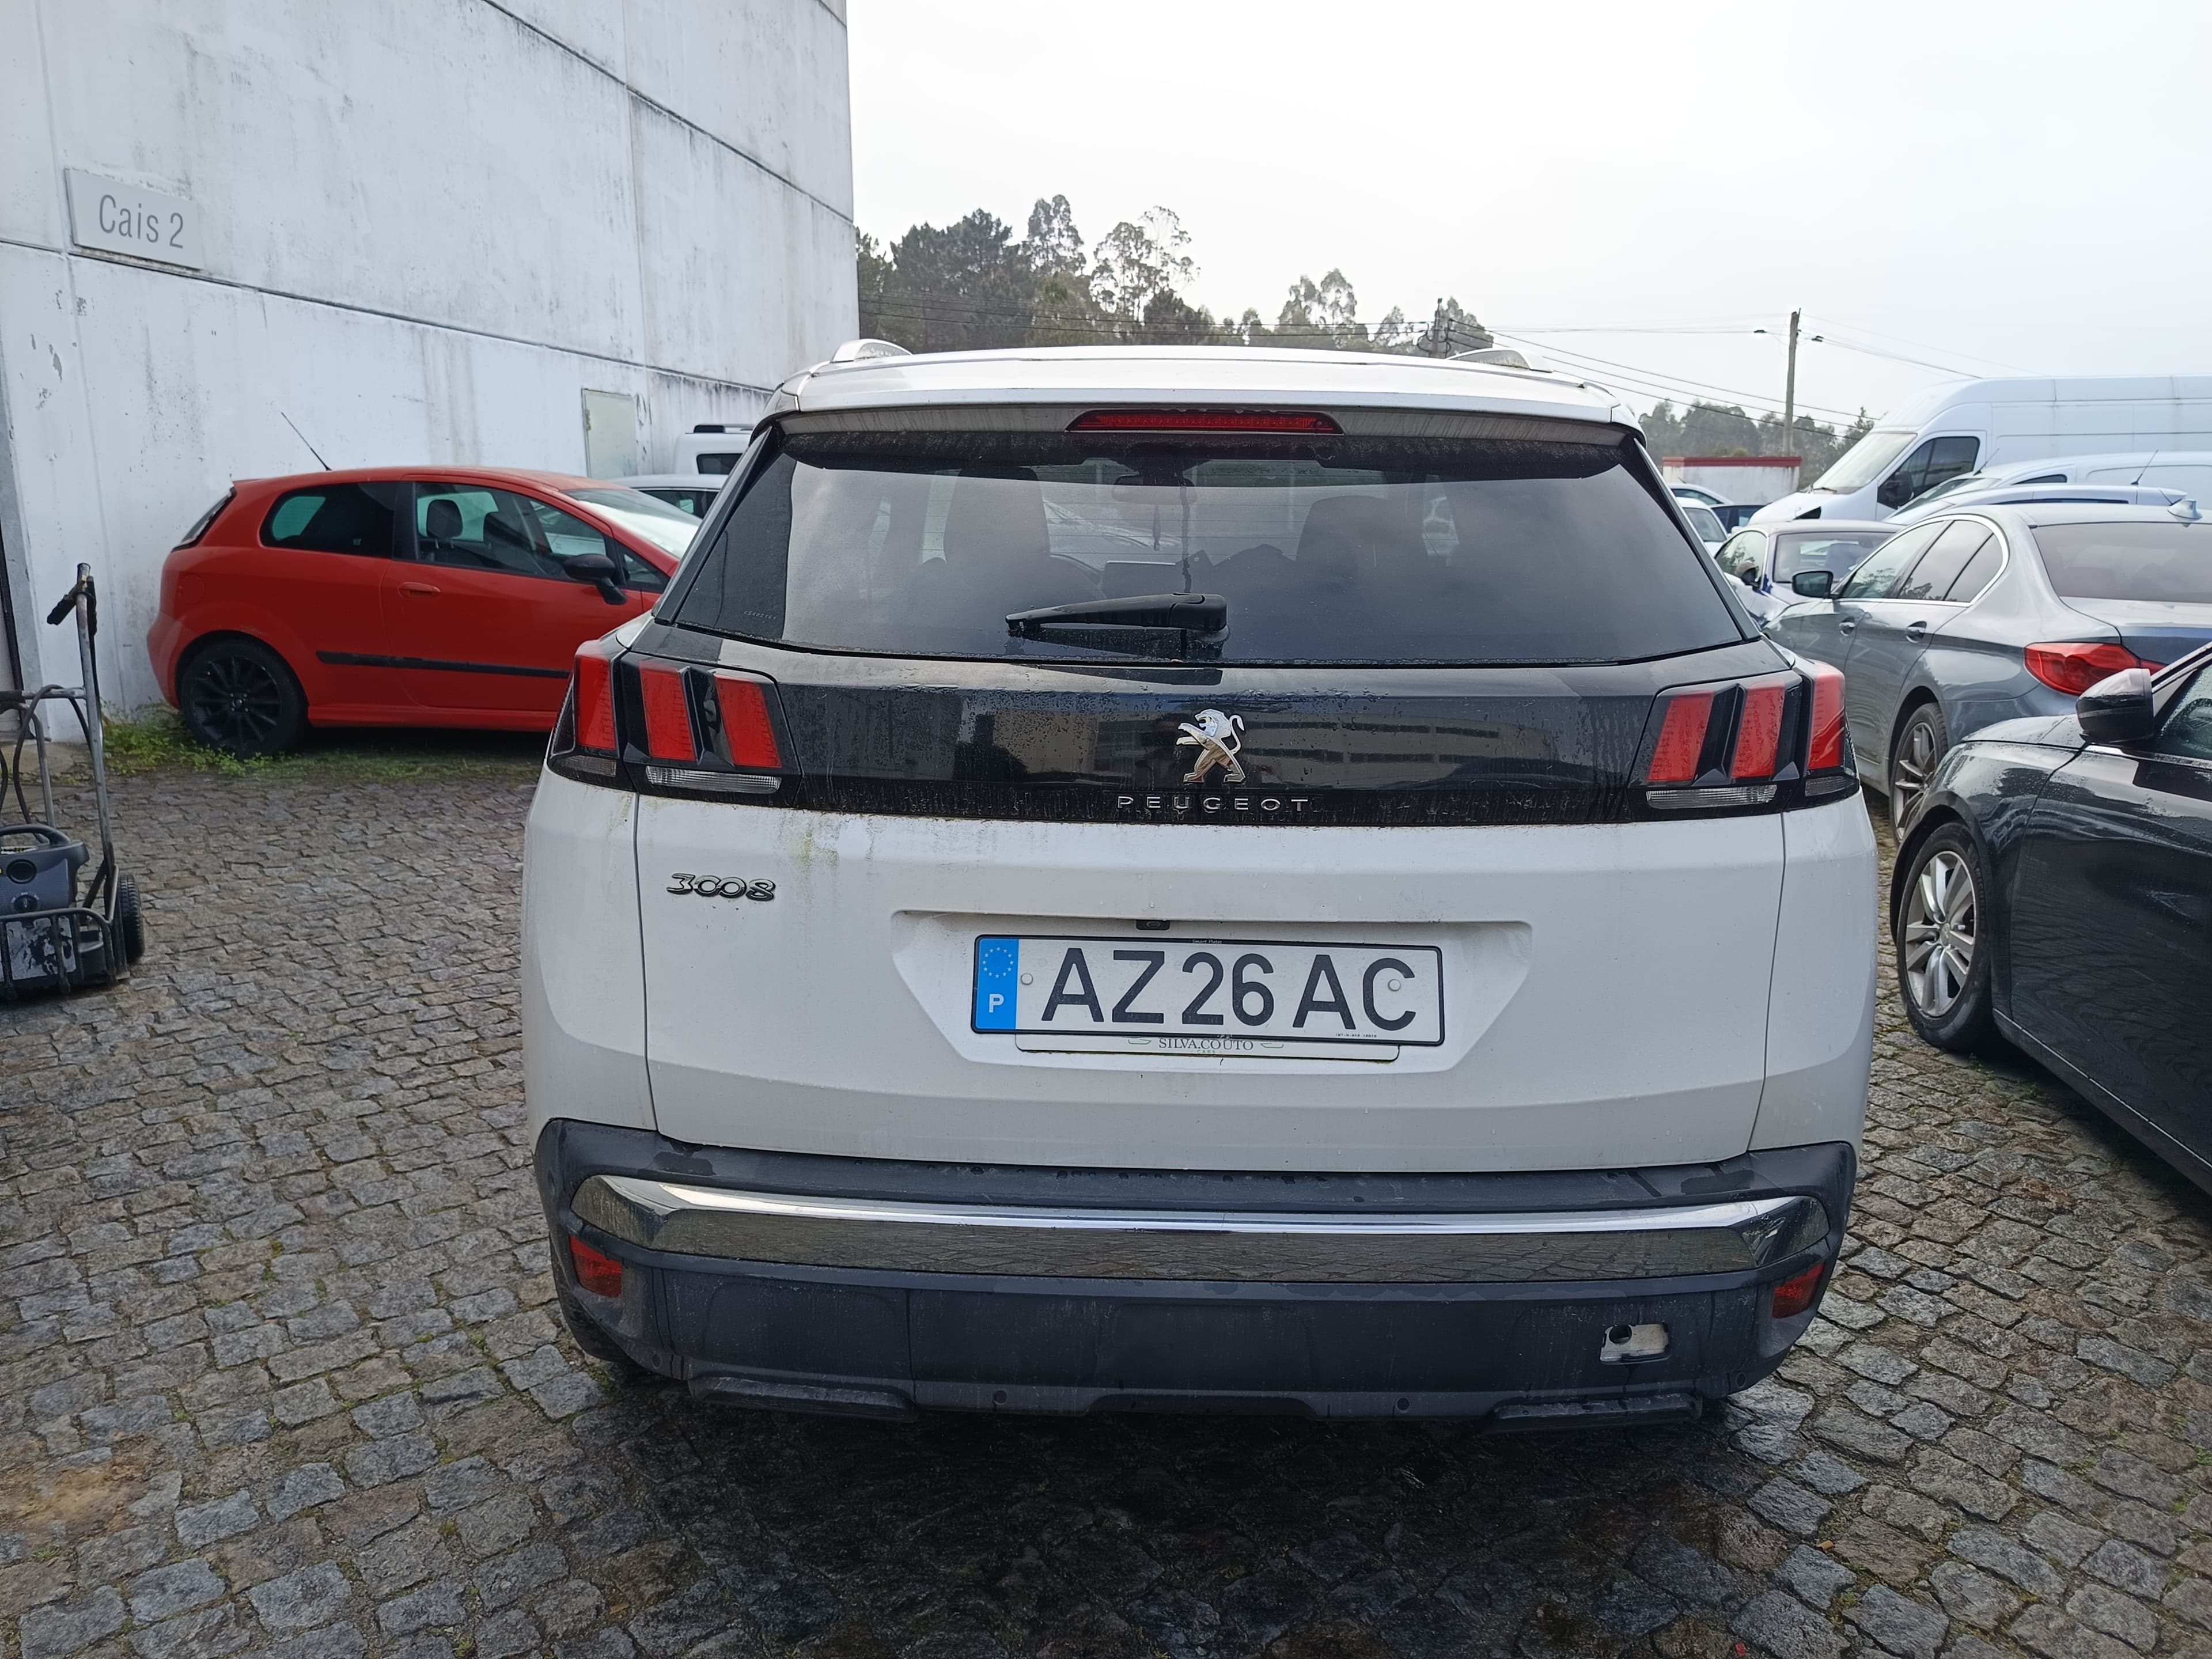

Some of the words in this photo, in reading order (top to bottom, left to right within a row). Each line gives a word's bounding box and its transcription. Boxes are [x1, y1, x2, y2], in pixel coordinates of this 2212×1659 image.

[99, 194, 159, 243] Cais
[169, 213, 184, 249] 2
[1118, 796, 1308, 812] PEUGEOT
[666, 873, 776, 902] 3008
[988, 994, 1005, 1013] P
[1041, 948, 1165, 1024] AZ
[1181, 952, 1274, 1026] 26
[1293, 954, 1416, 1030] AC
